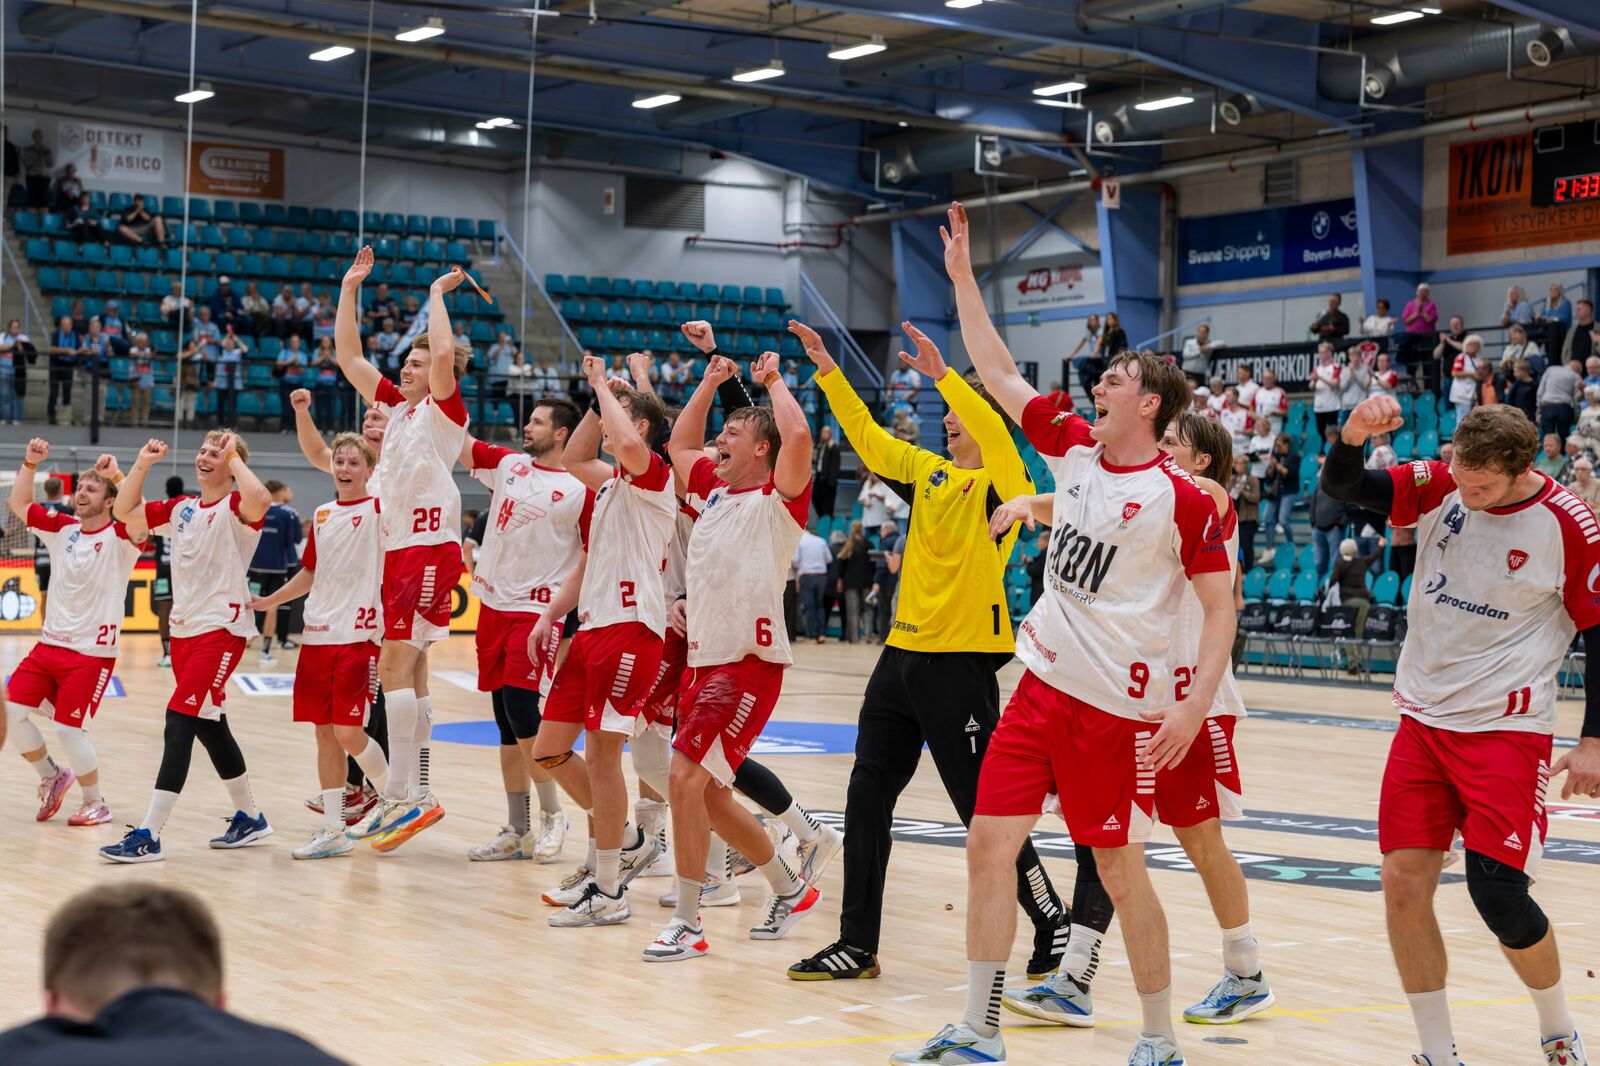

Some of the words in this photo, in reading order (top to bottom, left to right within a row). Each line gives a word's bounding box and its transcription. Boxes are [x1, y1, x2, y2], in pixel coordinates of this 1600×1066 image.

[85, 128, 143, 147] DETEKT
[114, 154, 162, 171] ASICO
[1106, 184, 1117, 200] V
[1223, 243, 1271, 262] Shipping
[1303, 247, 1333, 264] Bayern
[412, 506, 442, 534] 28
[619, 580, 638, 609] 2
[1434, 592, 1510, 621] procudan
[228, 602, 241, 624] 7
[354, 606, 378, 631] 22
[991, 603, 1001, 636] 1
[95, 623, 117, 647] 27
[754, 617, 773, 648] 6
[1127, 661, 1150, 699] 9
[1173, 664, 1199, 702] 2
[1502, 685, 1532, 718] 11
[964, 724, 981, 733] SELECT
[1502, 839, 1523, 851] SELECT
